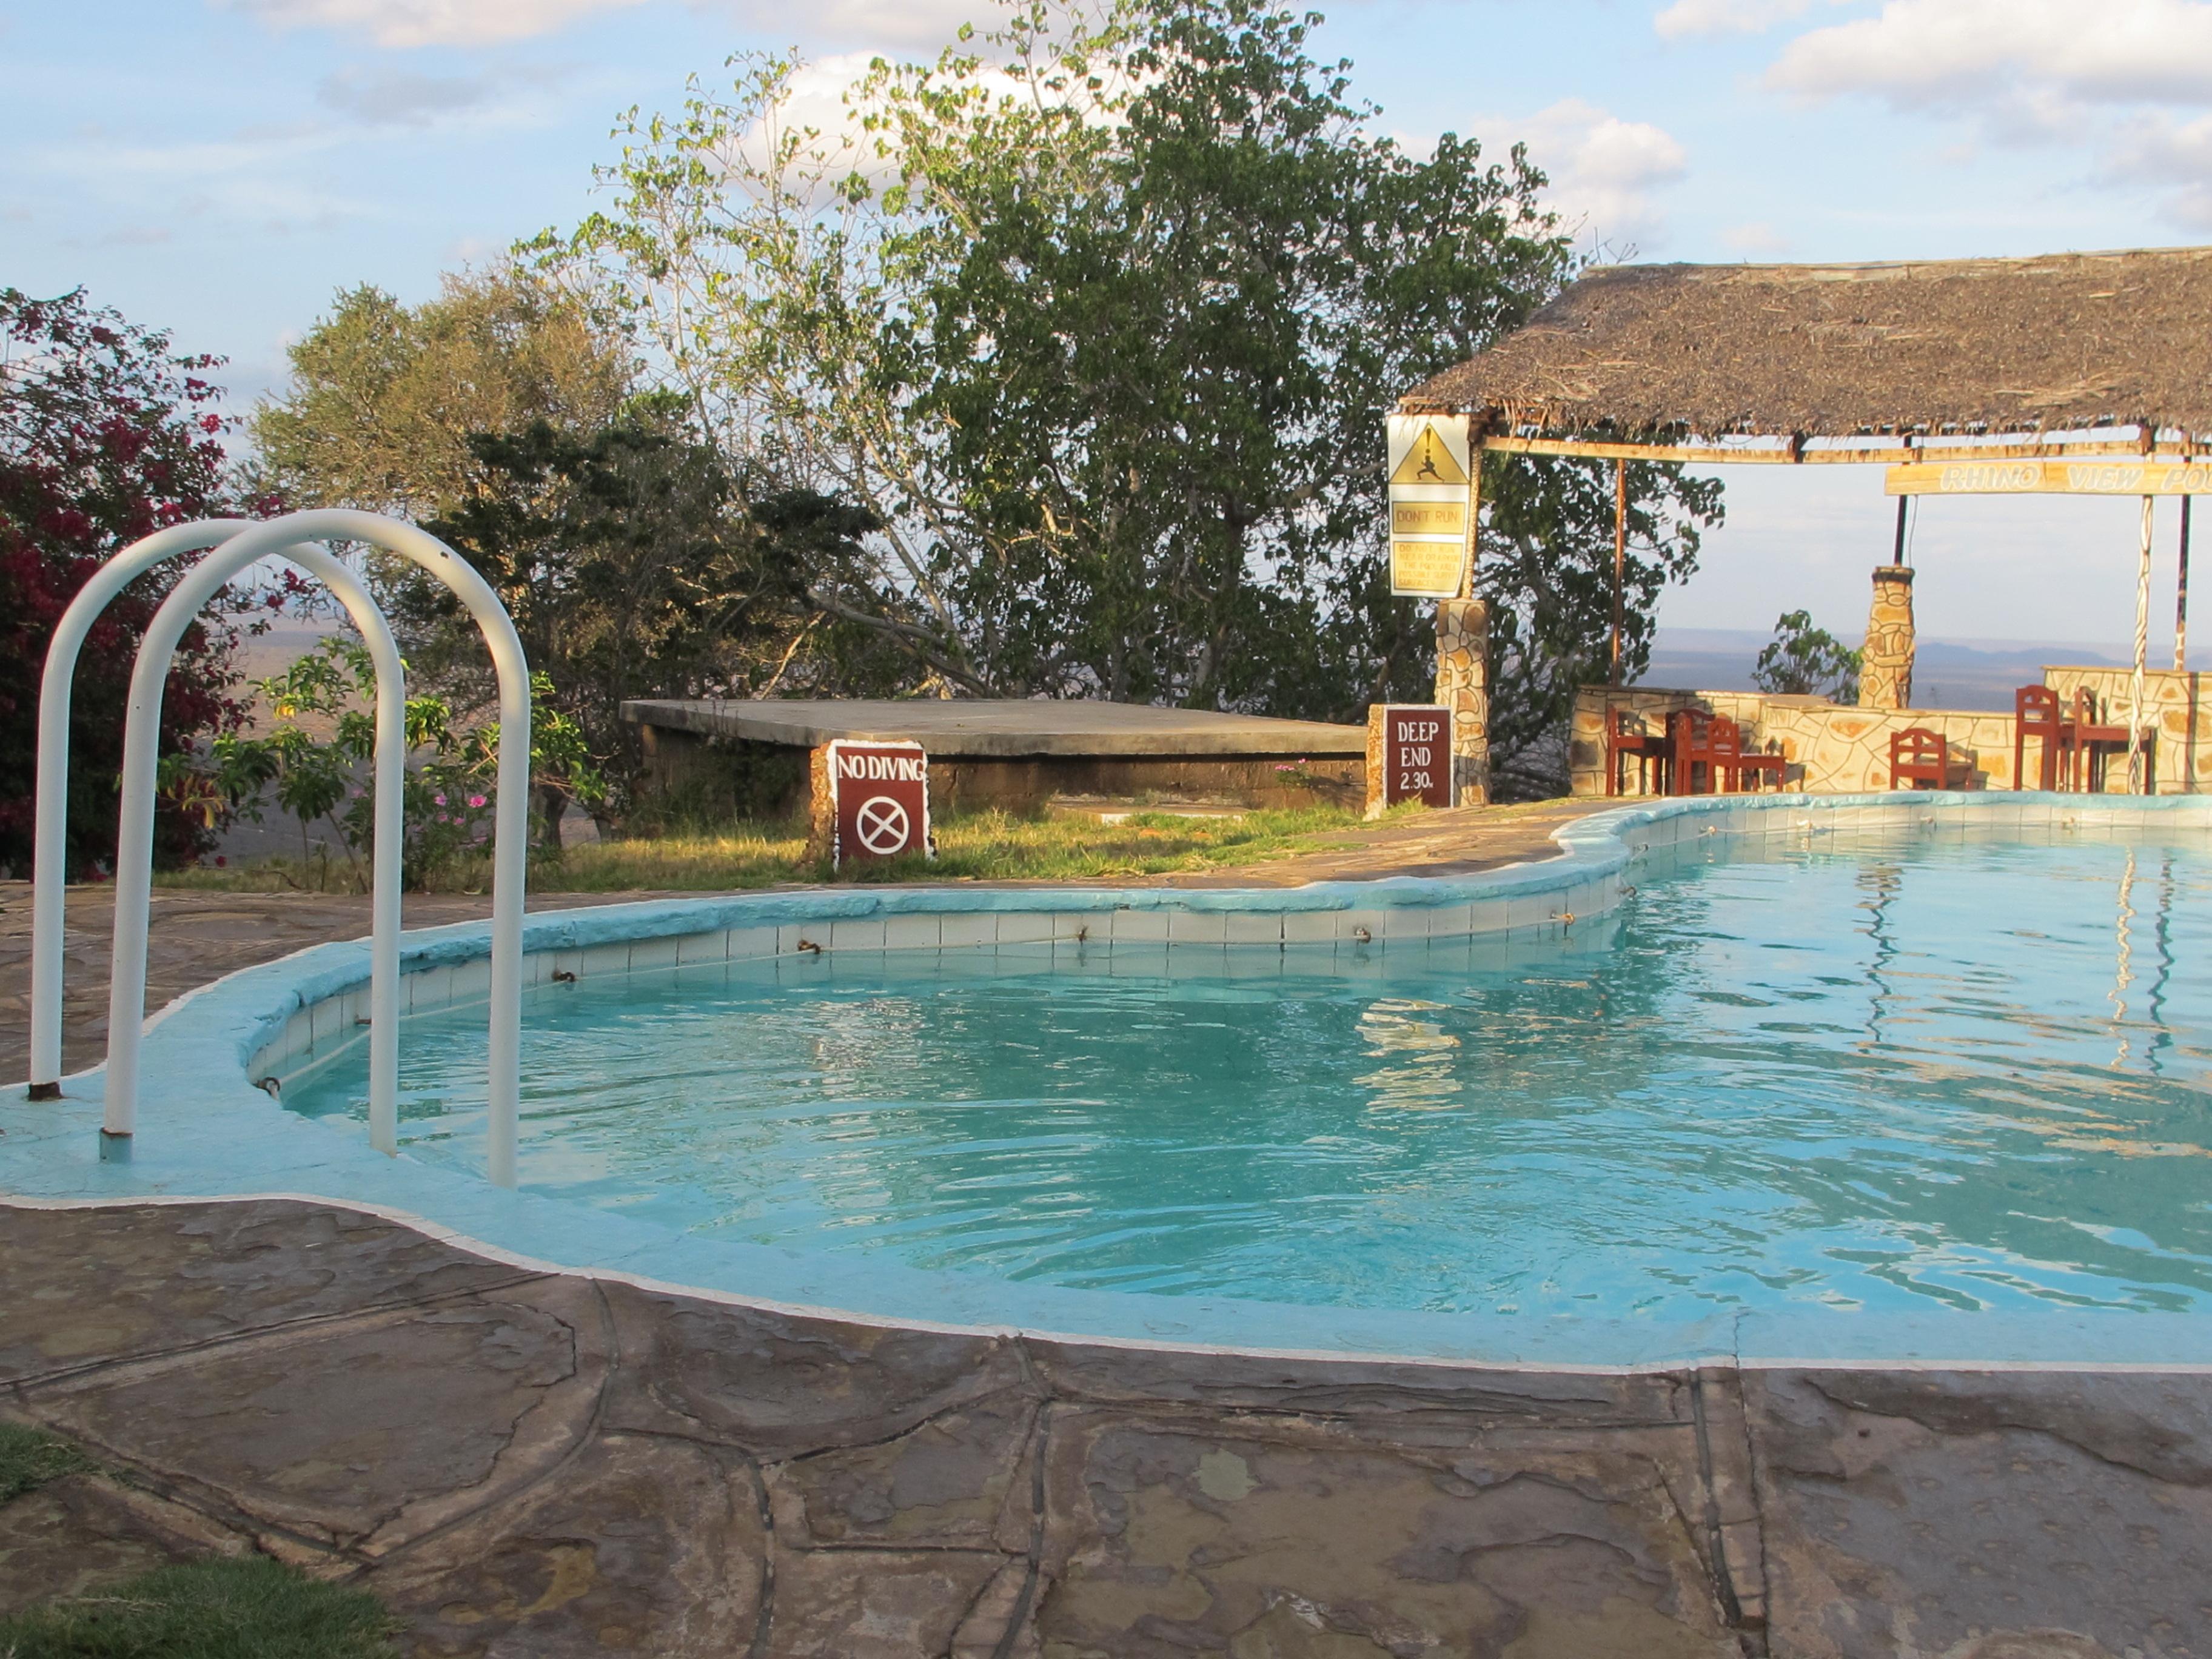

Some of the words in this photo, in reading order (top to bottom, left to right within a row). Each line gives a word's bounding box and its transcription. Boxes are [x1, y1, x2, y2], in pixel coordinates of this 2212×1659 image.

[1940, 465, 2039, 491] RHINO
[2067, 466, 2145, 491] VIEW
[1397, 722, 1439, 742] DEEP
[837, 755, 866, 780] NO
[868, 756, 923, 781] DIVING
[1401, 747, 1432, 767] END
